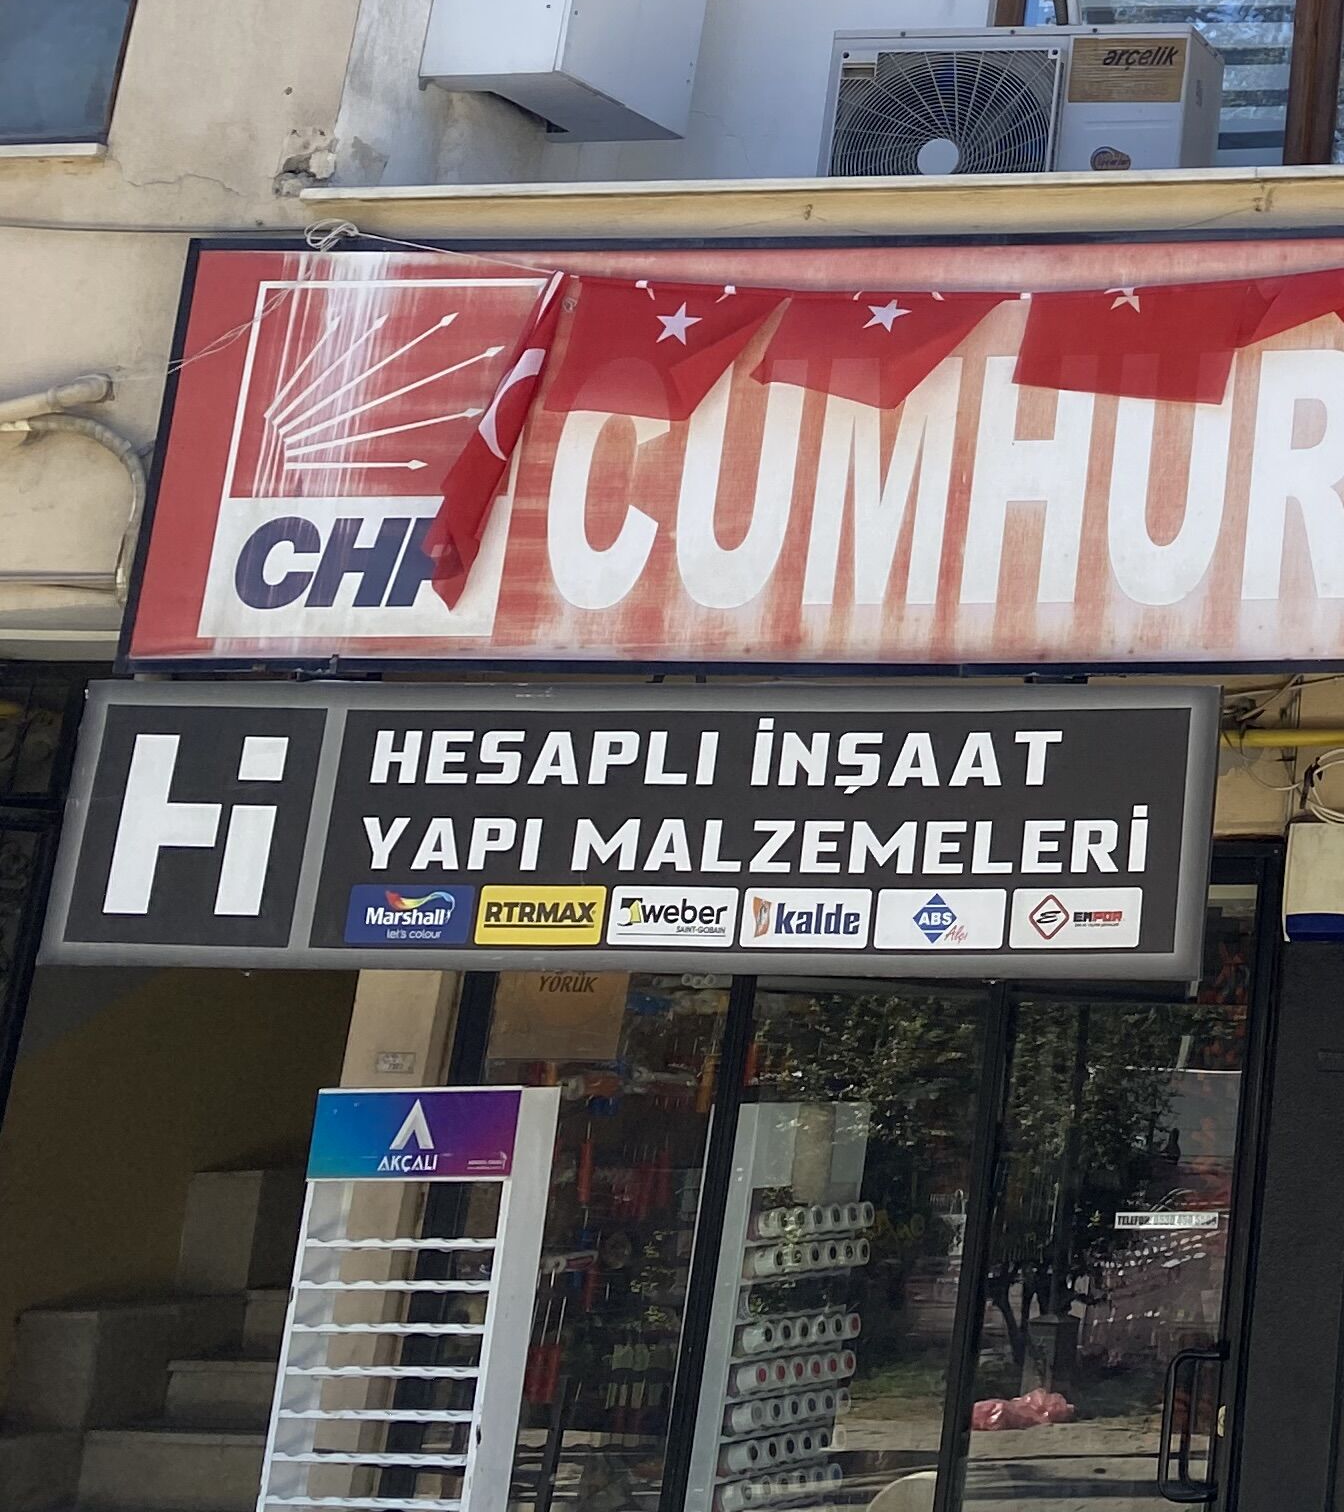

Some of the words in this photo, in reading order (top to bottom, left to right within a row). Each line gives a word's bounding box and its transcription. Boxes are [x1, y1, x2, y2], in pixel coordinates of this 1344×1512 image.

[1102, 46, 1181, 71] arçelik
[369, 729, 720, 786] HESAPLI
[750, 717, 1063, 795] İNŞAAT
[362, 816, 544, 872] YAPI
[570, 804, 1149, 875] MALZEMELERİ
[365, 905, 447, 927] Marshall
[484, 902, 596, 924] RTRMAX
[640, 900, 728, 925] weber
[774, 902, 861, 936] kalde
[918, 911, 953, 926] ABS
[409, 929, 442, 940] colour
[377, 1154, 438, 1172] AKÇALI
